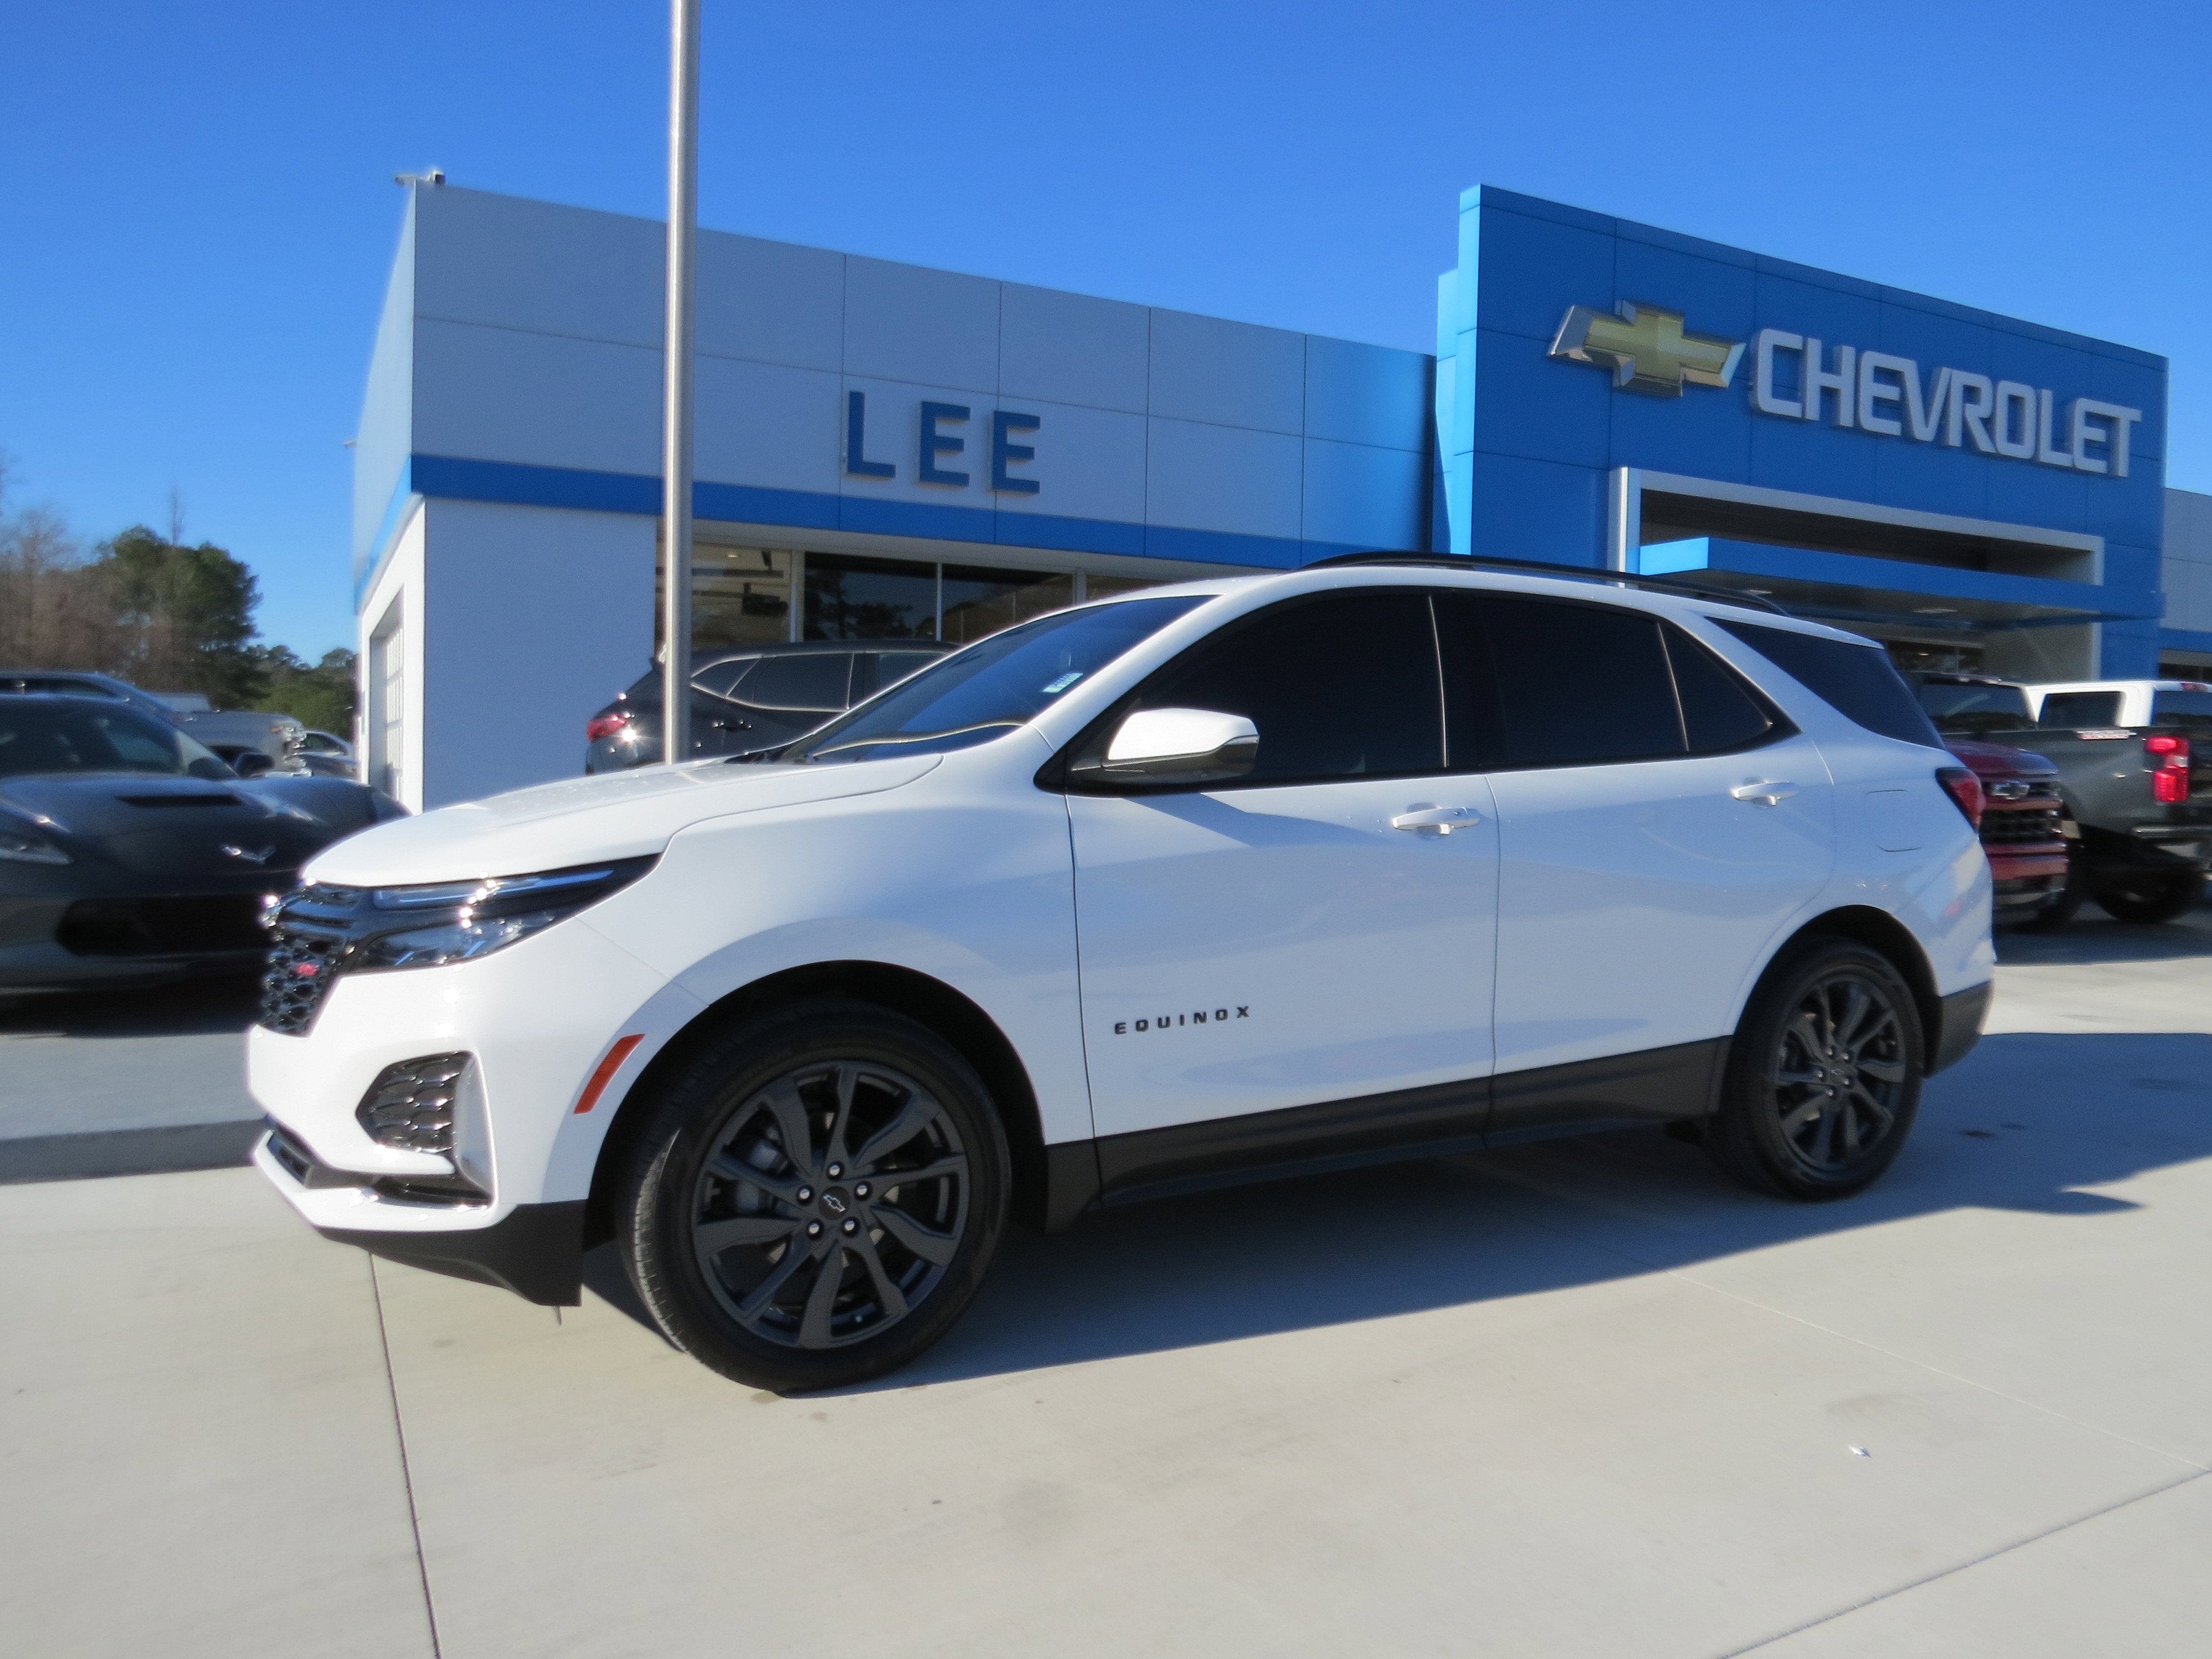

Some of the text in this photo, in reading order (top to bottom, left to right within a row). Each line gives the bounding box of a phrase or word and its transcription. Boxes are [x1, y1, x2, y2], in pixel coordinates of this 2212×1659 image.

[846, 391, 1041, 494] LEE
[1753, 328, 2142, 477] CHEVROLET
[1114, 1006, 1249, 1035] EQUINOX
